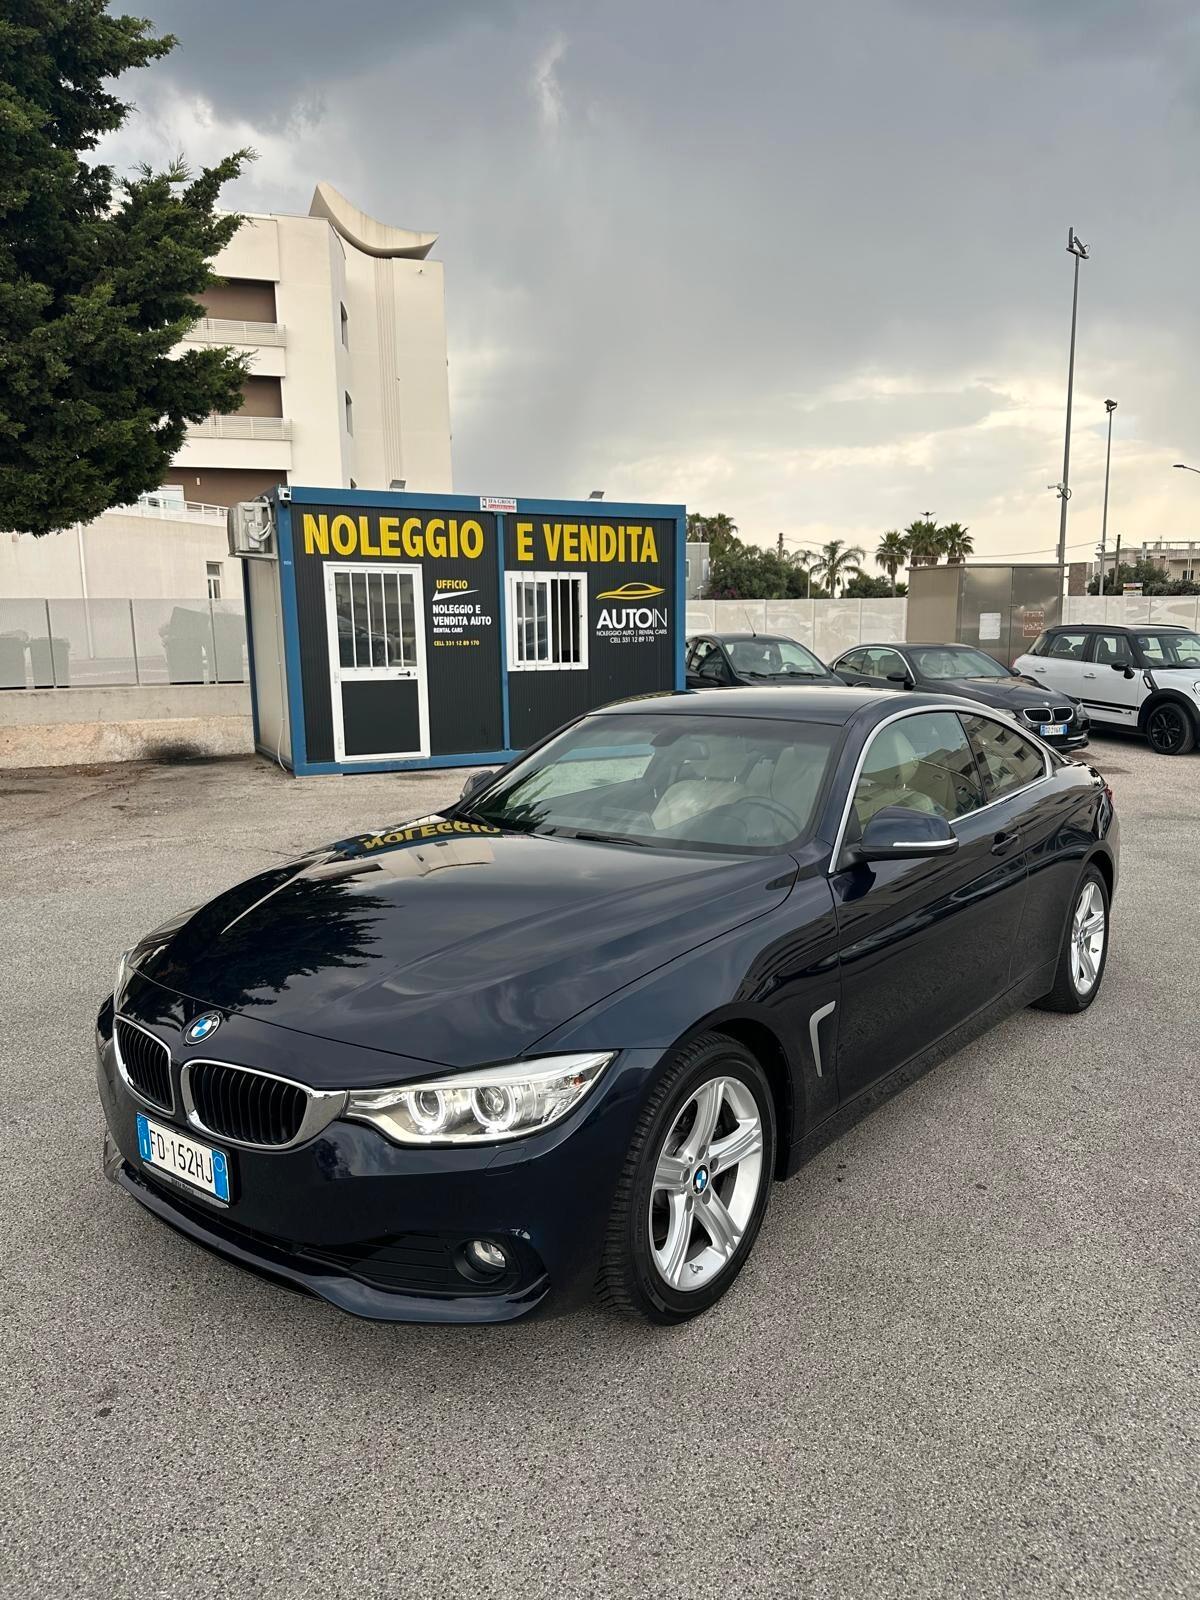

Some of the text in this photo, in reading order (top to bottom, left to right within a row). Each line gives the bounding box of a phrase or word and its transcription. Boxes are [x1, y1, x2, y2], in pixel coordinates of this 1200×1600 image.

[303, 514, 484, 559] NOLEGGIO
[517, 523, 658, 563] E VENDITA
[436, 580, 468, 589] UFFICIO
[433, 605, 481, 614] NOLEGGIO E
[433, 616, 492, 626] VENDITA AUTO
[150, 1130, 213, 1184] FD 152HJ
